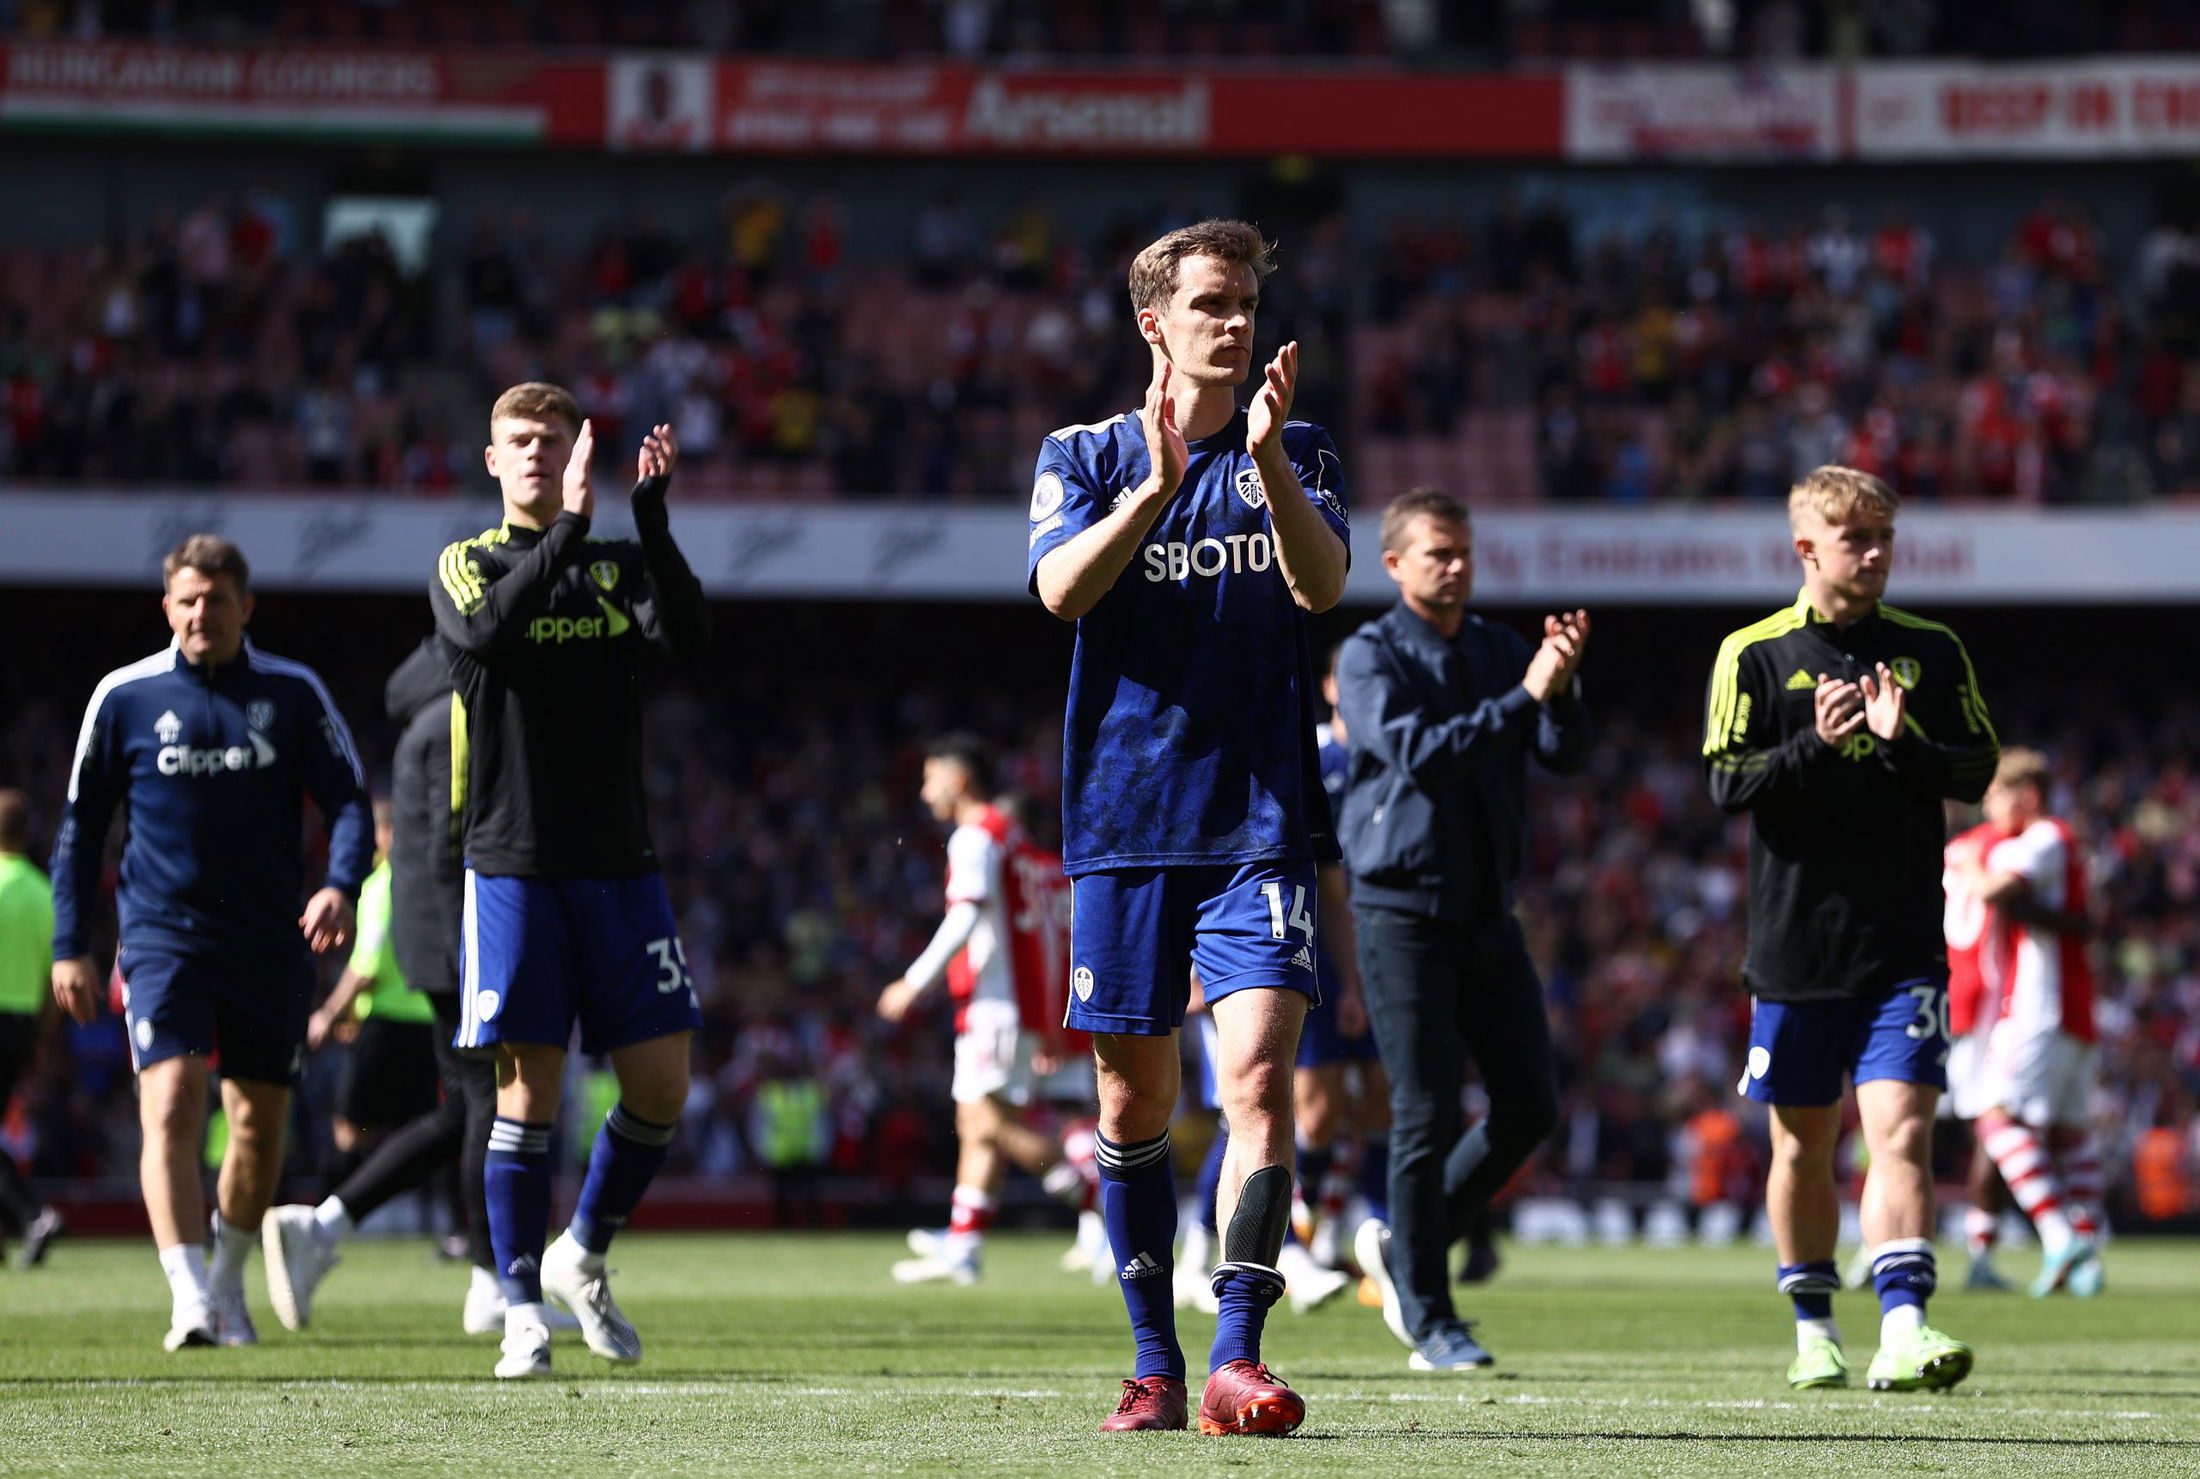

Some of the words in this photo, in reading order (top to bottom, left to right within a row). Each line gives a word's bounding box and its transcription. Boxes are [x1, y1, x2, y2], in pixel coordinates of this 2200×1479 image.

[967, 74, 1210, 147] Arsenal
[1144, 533, 1277, 582] SBOTO
[528, 614, 603, 645] ipper
[157, 743, 252, 777] Clipper
[1261, 882, 1313, 947] 14
[1121, 1266, 1164, 1279] adidas
